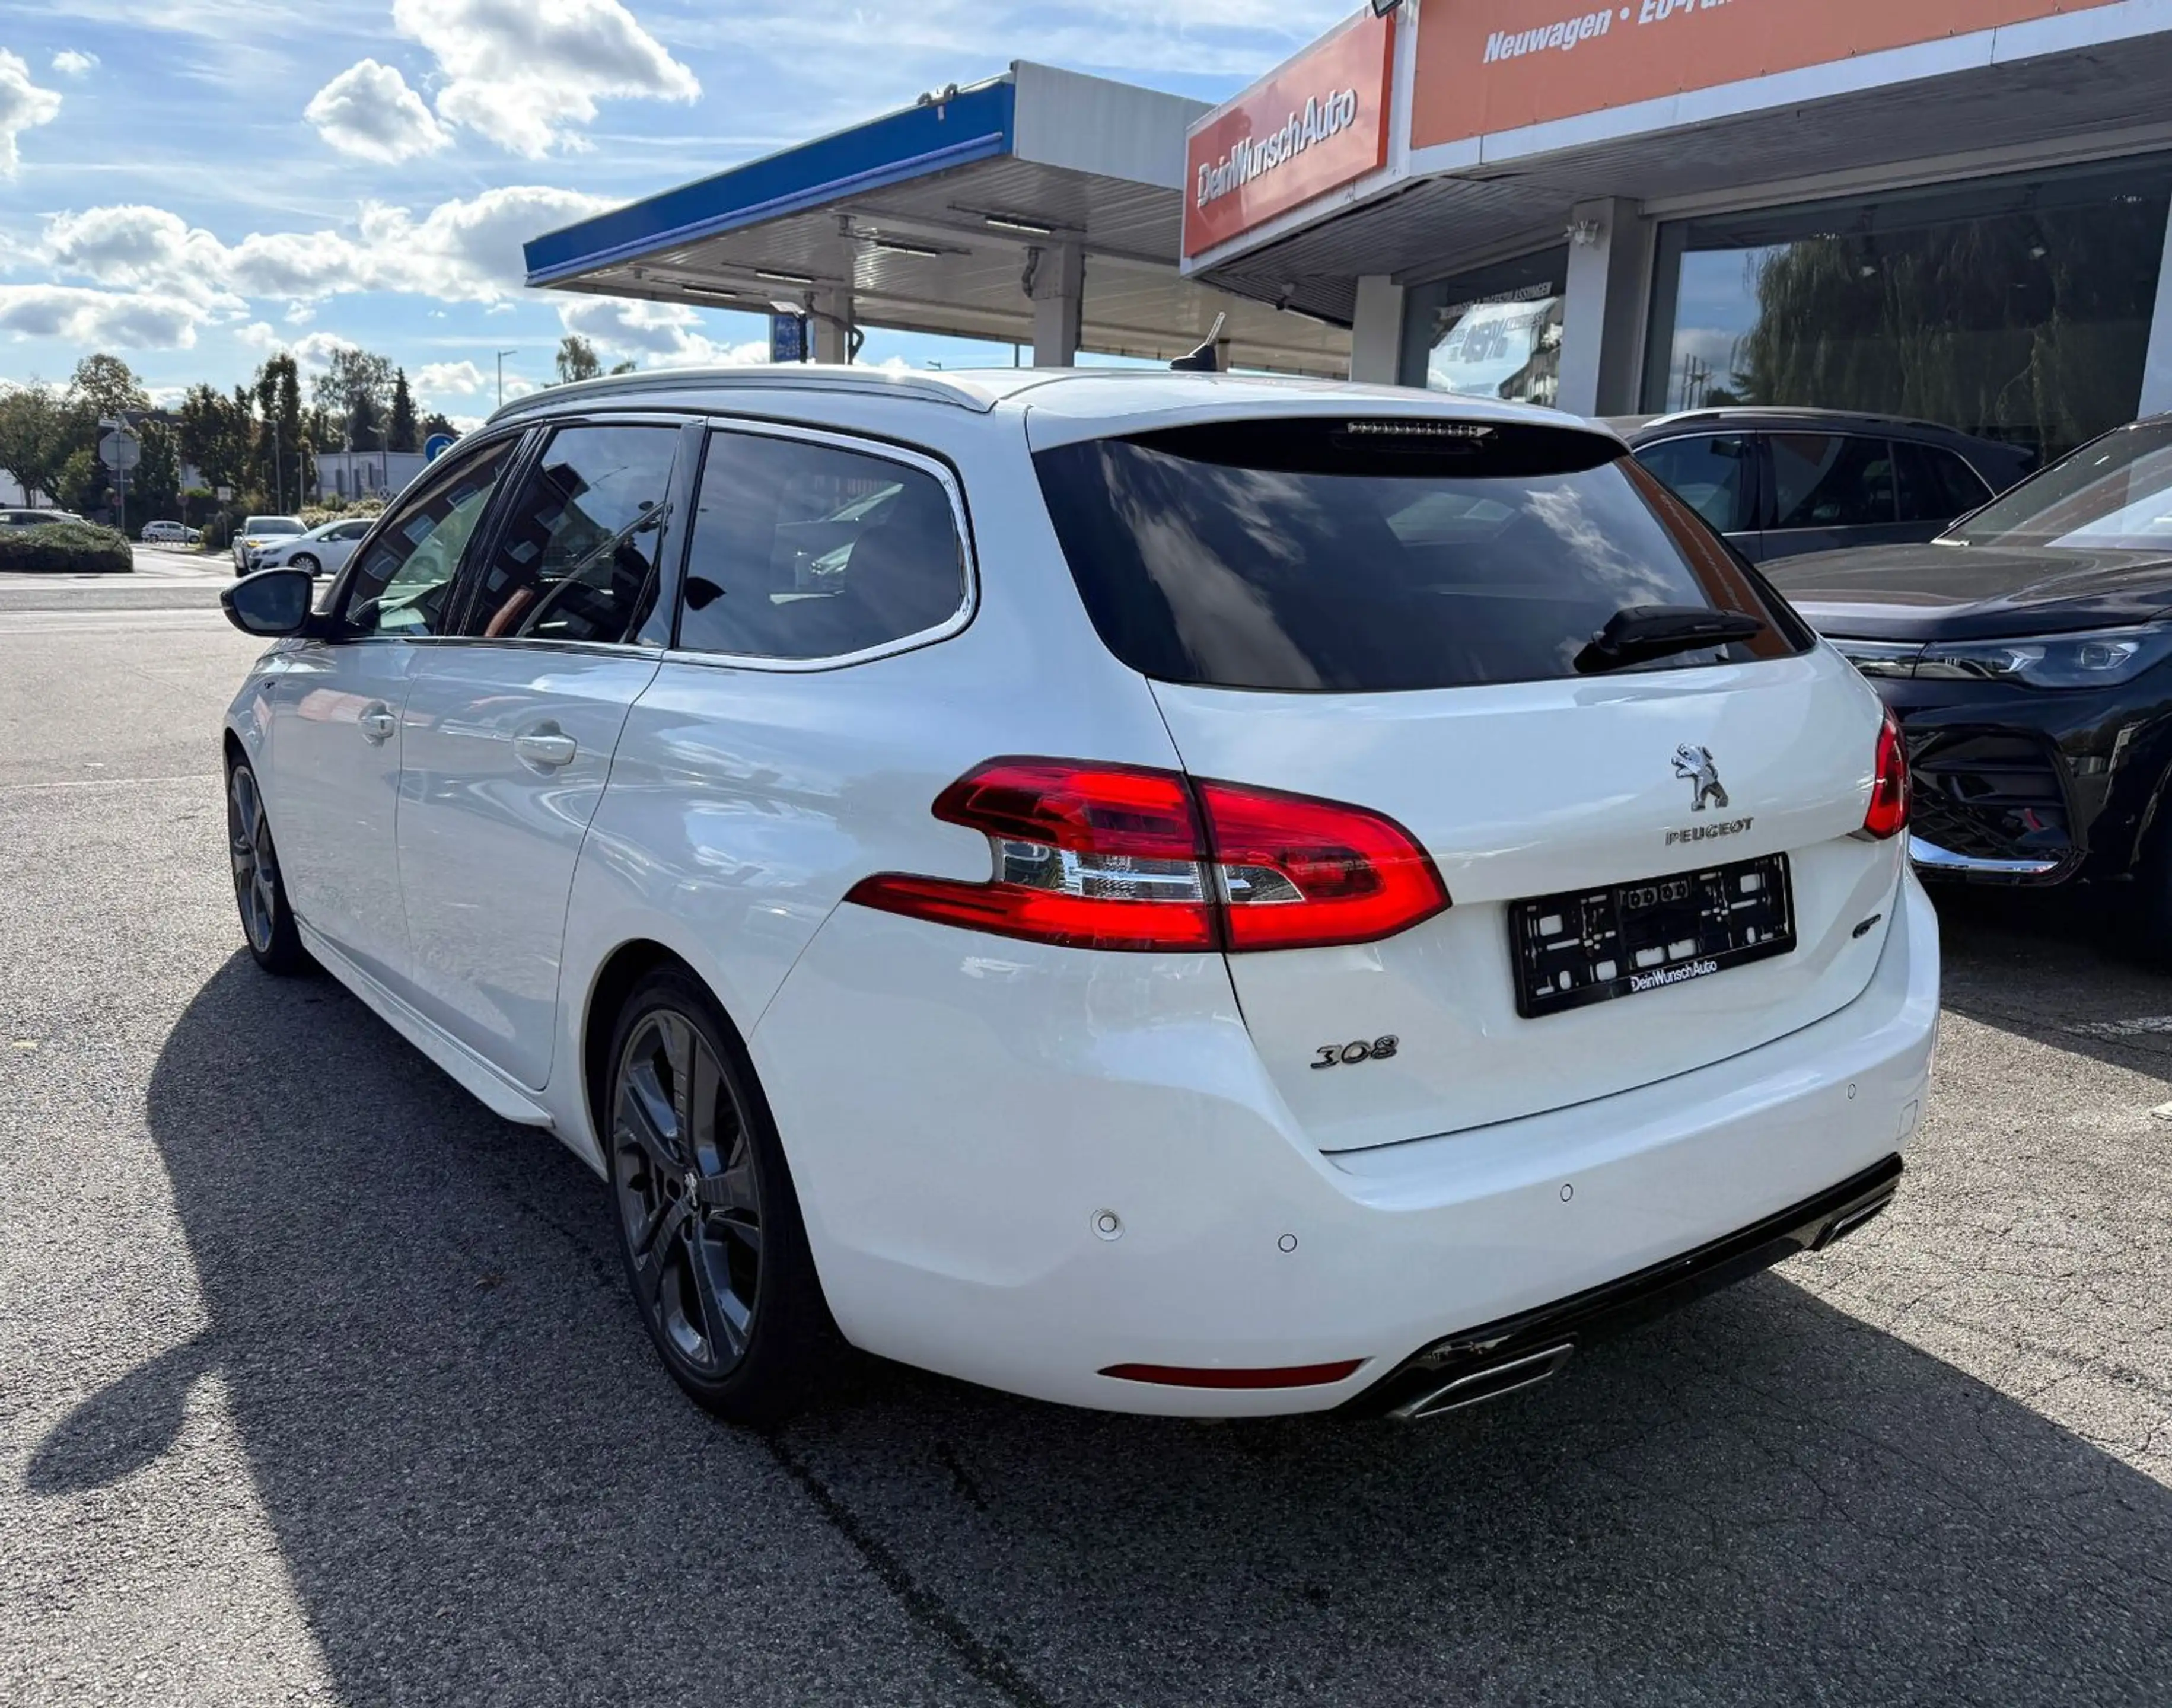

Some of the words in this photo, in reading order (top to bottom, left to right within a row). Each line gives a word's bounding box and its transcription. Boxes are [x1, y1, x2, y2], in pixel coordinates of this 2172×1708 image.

[1483, 8, 1612, 63] Neuwagen
[1198, 88, 1356, 208] DeinWunschAuto
[1665, 817, 1754, 846] PEUGEOT
[1631, 960, 1718, 992] DeinWunschAuto
[1310, 1034, 1399, 1069] 308
